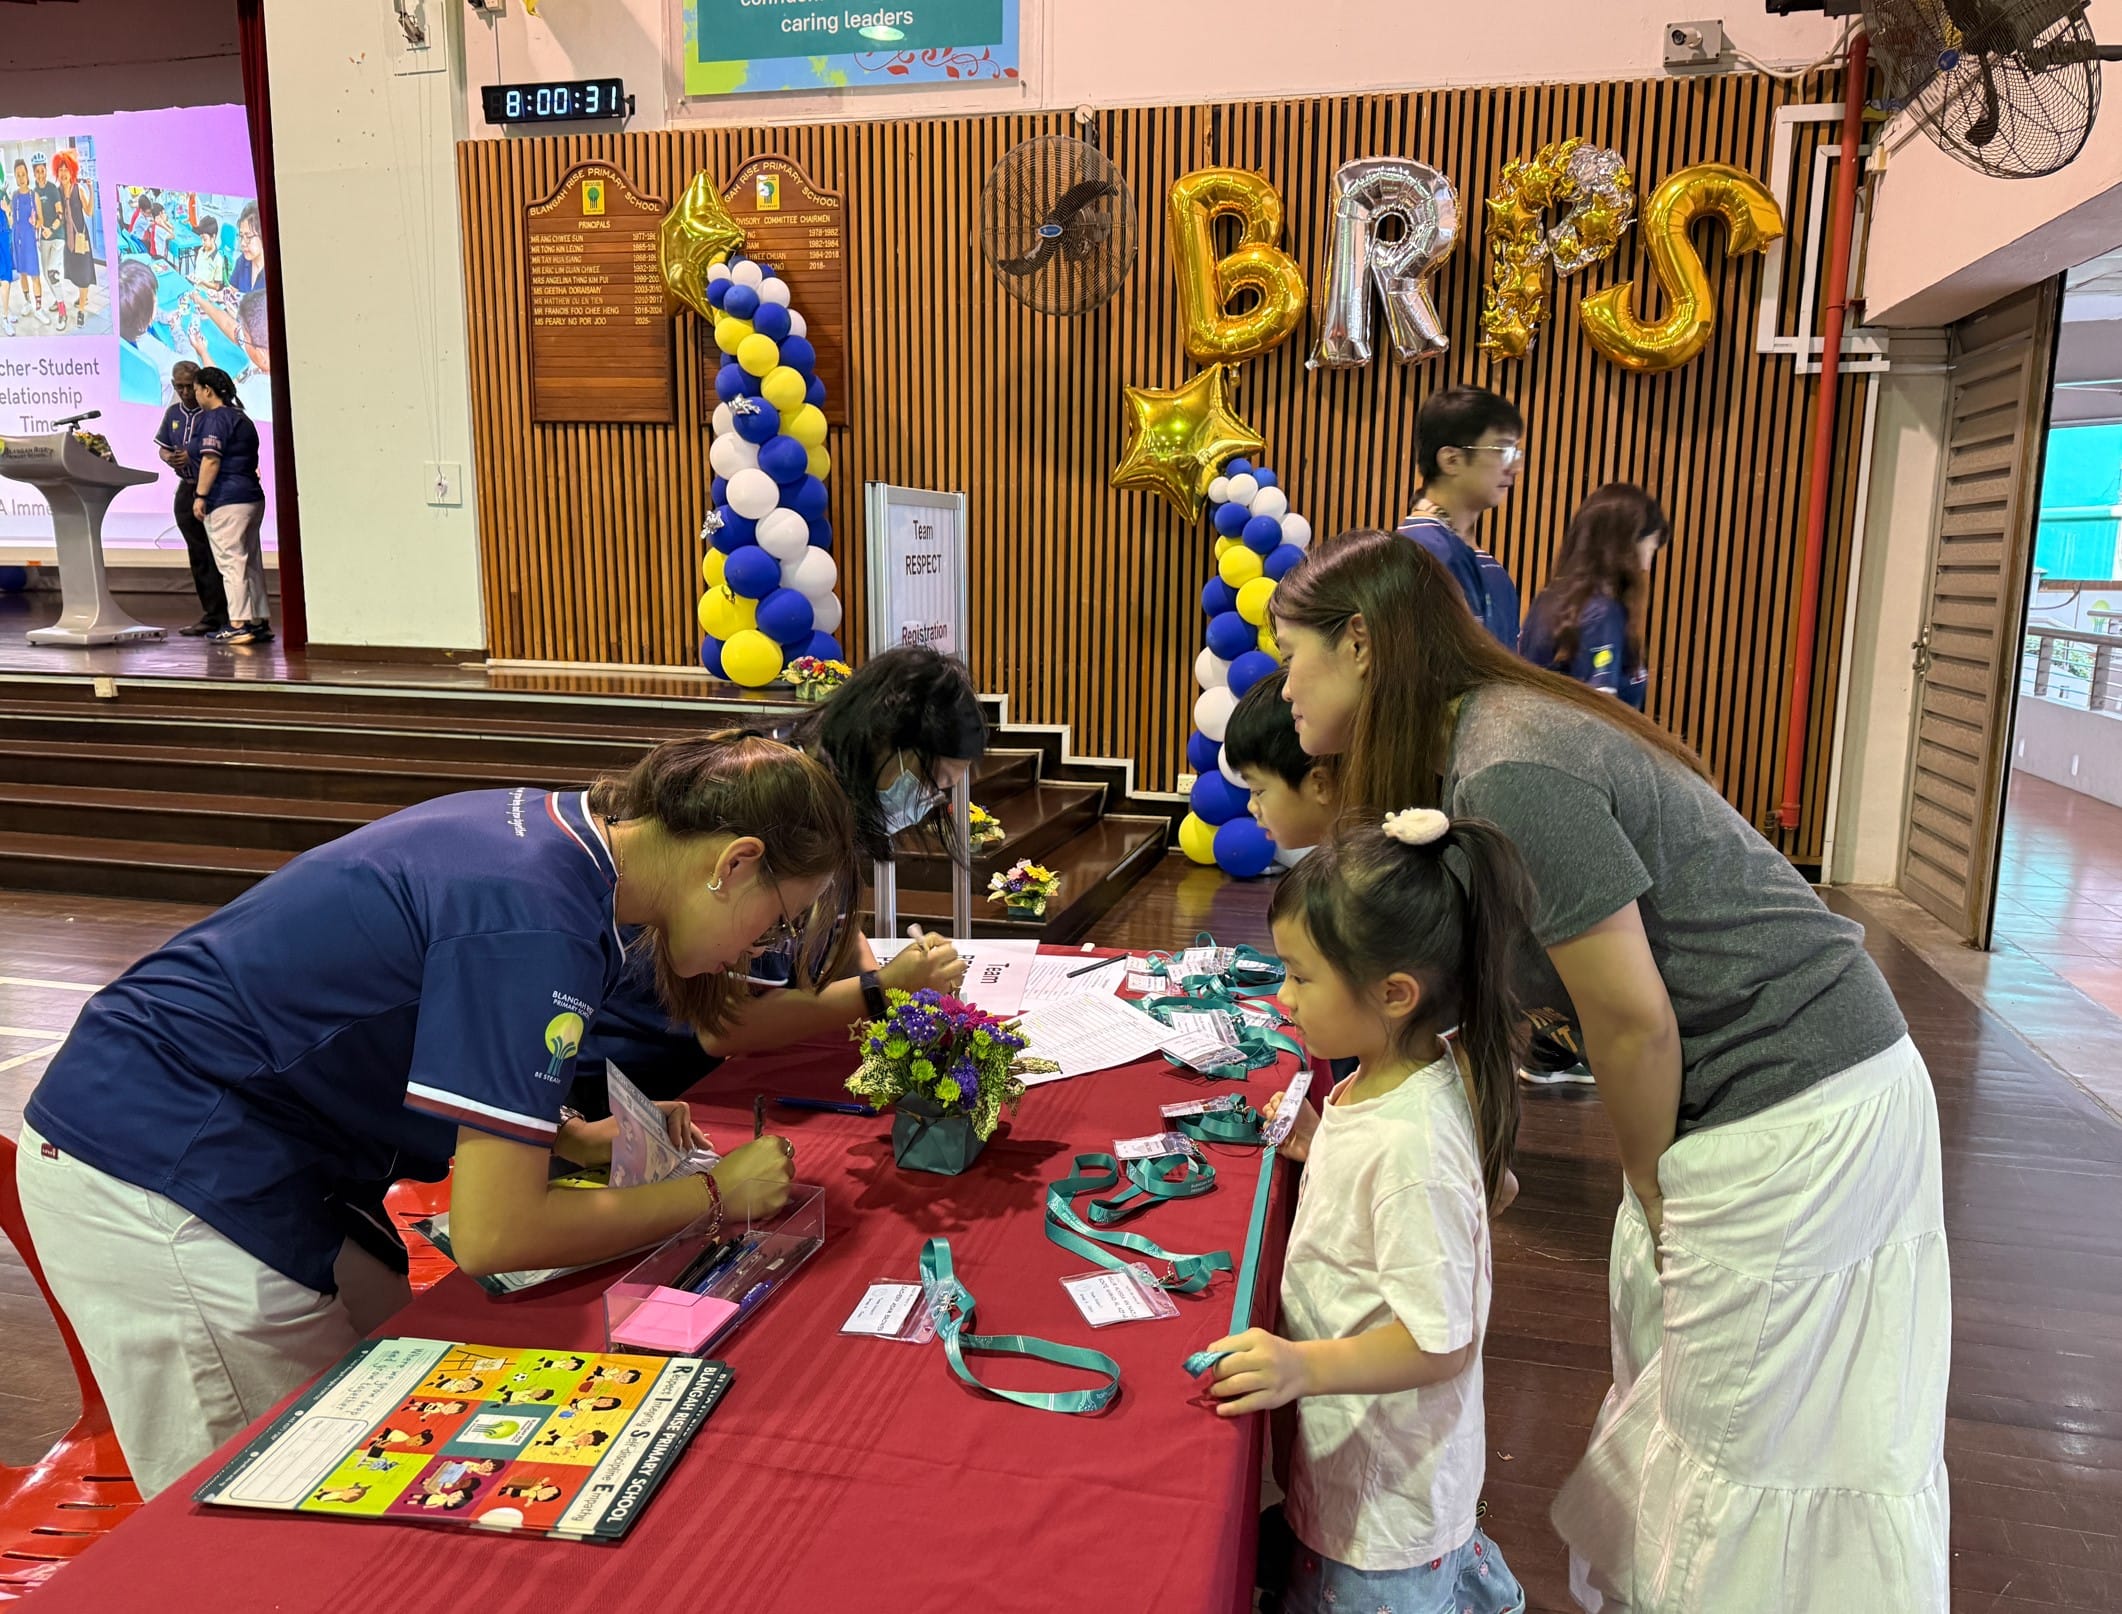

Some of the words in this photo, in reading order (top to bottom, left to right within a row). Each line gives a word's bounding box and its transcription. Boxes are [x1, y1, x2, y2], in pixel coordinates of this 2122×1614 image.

[781, 12, 838, 34] caring
[844, 7, 914, 28] leaders
[506, 85, 617, 118] 8:00:31
[529, 190, 569, 216] BLANGAH
[566, 169, 585, 190] RISE
[587, 167, 627, 191] PRIMARY
[624, 191, 661, 212] SCHOOL
[740, 164, 760, 184] RISE
[763, 161, 803, 185] PRIMARY
[801, 187, 839, 207] SCHOOL
[578, 221, 611, 229] PRINCIPALS
[735, 217, 761, 225] DVISORY
[763, 215, 798, 225] COMMITTEE
[799, 214, 831, 223] CHAIRMEN
[530, 235, 540, 243] MR
[571, 234, 584, 242] SUN
[531, 245, 540, 254] MR
[544, 287, 567, 295] GEETHA
[534, 307, 543, 315] MR
[544, 307, 569, 315] FRANCIS
[570, 307, 583, 315] FOO
[602, 306, 620, 315] HENG
[534, 317, 544, 326] MS
[545, 317, 567, 325] PEARLY
[567, 317, 578, 325] NG
[579, 317, 593, 325] POR
[594, 317, 607, 325] JOO
[0, 386, 84, 408] elationship
[19, 415, 59, 433] Time
[912, 519, 935, 542] Team
[905, 553, 943, 577] RESPECT
[901, 620, 948, 648] Registration
[980, 962, 1010, 984] Team
[552, 990, 587, 1009] BLANGAH
[553, 998, 578, 1013] PRIMARY
[534, 1071, 542, 1079] BE
[684, 1366, 718, 1411] BLANGAH
[665, 1412, 691, 1431] RISE
[638, 1431, 677, 1476] PRIMARY
[571, 1484, 615, 1522] Empathy
[606, 1478, 648, 1524] SCHOOL
